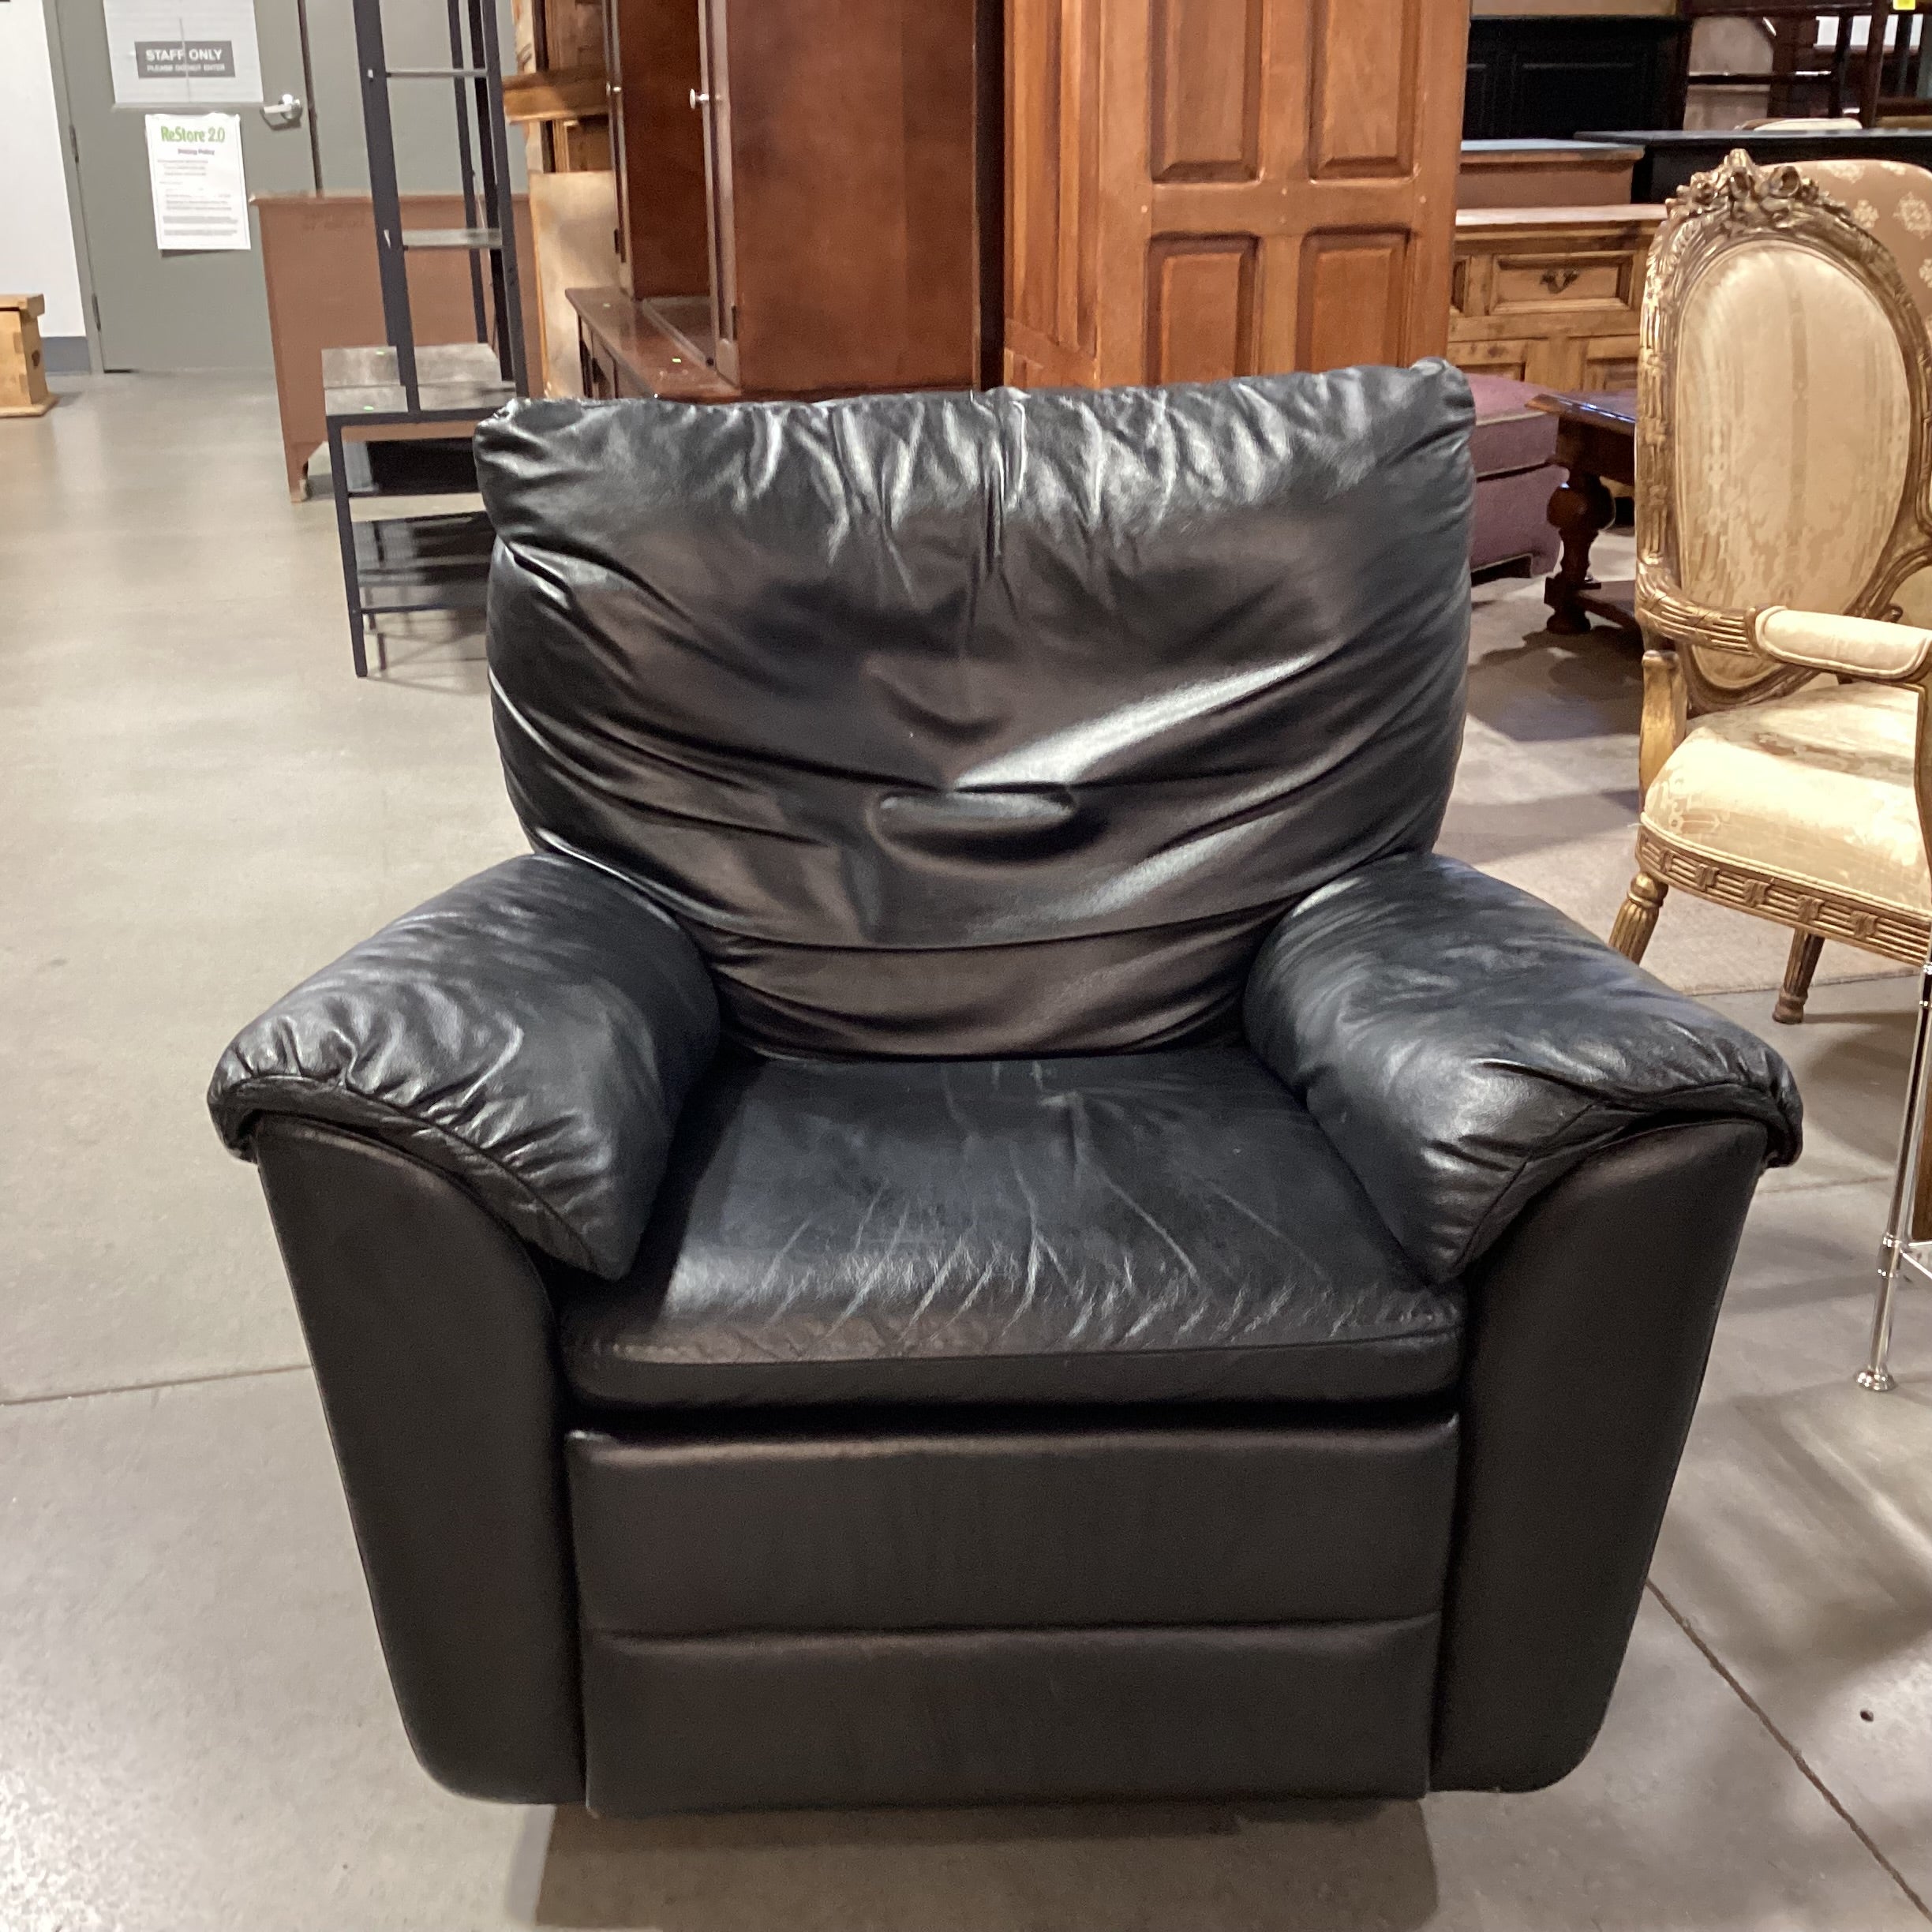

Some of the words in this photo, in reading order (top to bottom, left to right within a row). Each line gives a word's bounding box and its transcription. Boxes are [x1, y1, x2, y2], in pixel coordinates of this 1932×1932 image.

[145, 48, 185, 62] STAFF
[189, 48, 223, 61] ONLY
[160, 125, 205, 143] ReStore
[208, 126, 226, 143] 2.0
